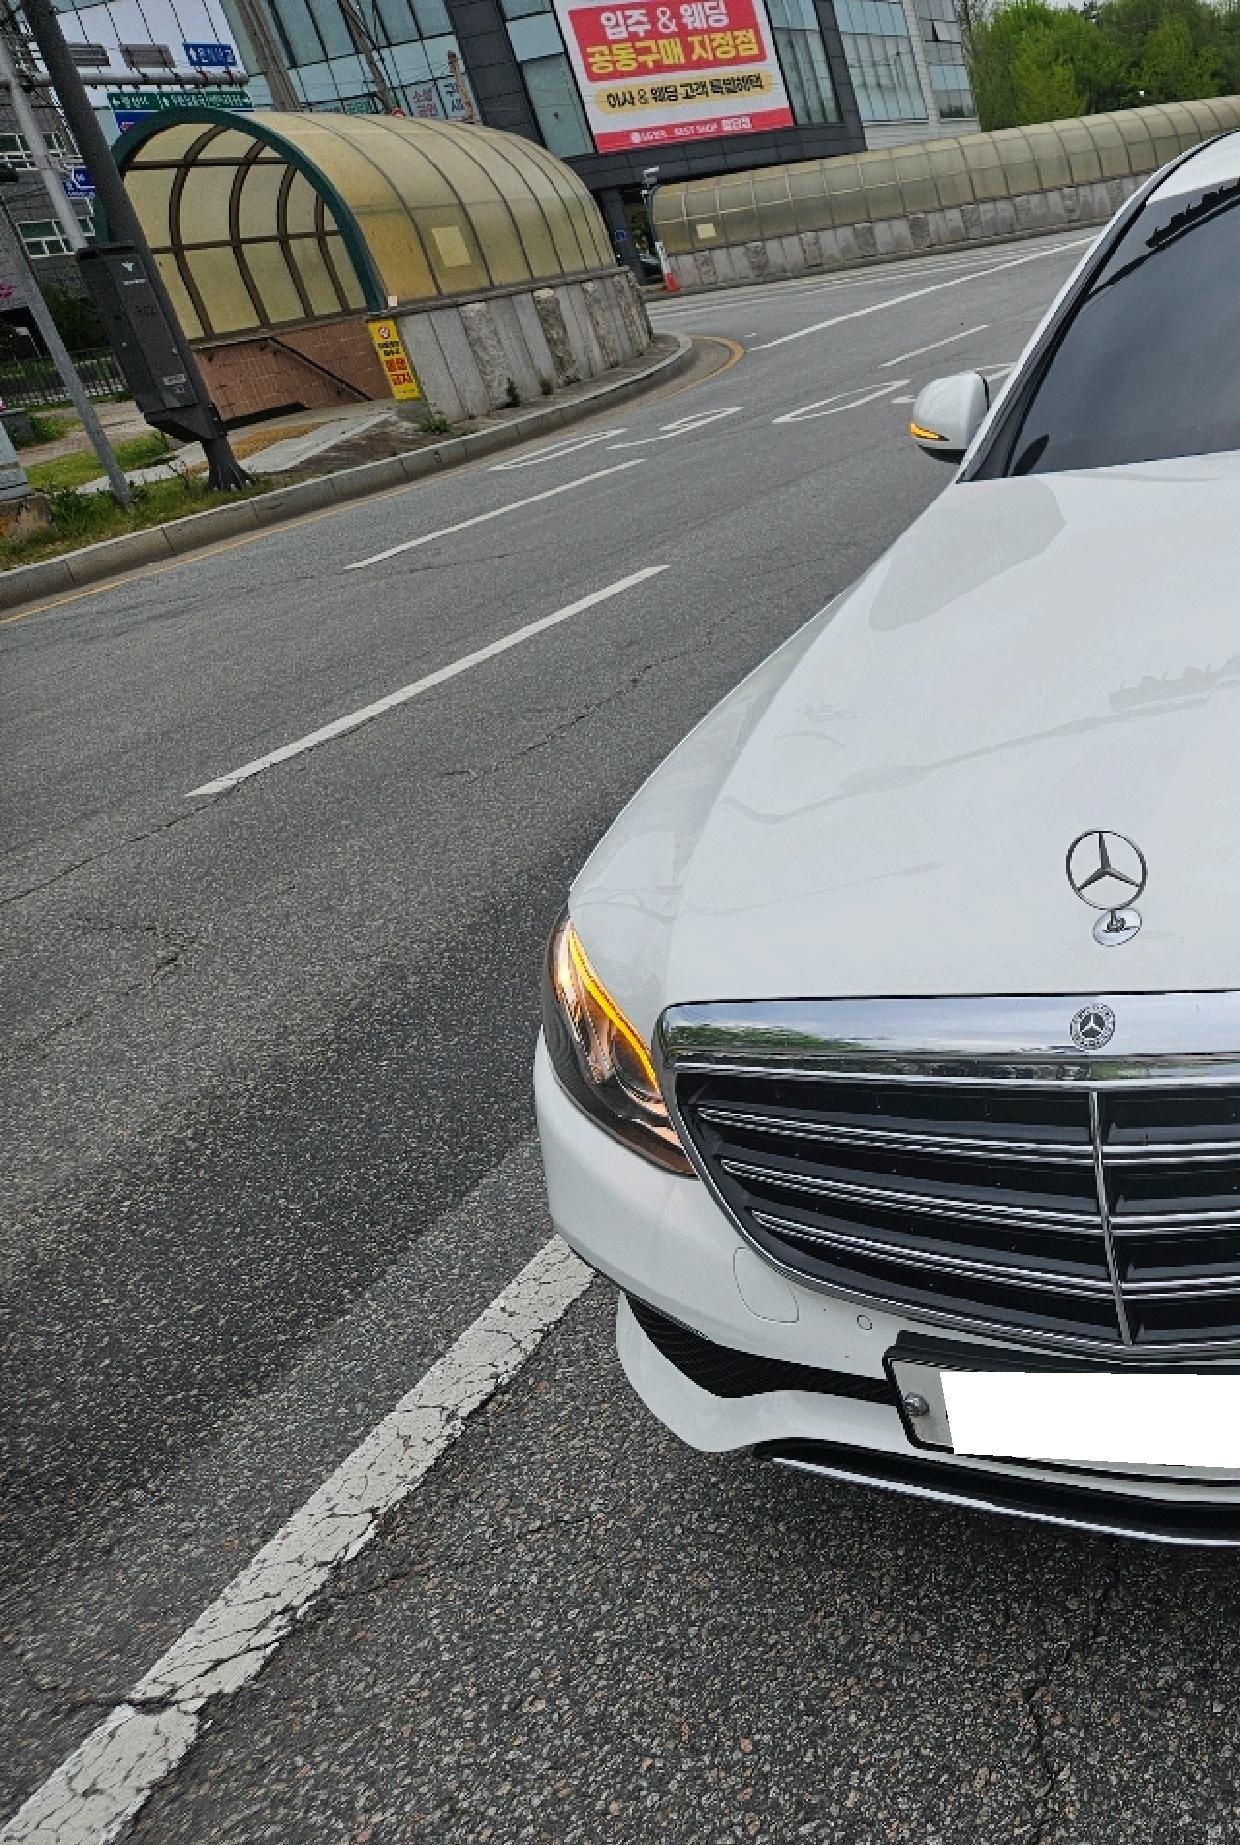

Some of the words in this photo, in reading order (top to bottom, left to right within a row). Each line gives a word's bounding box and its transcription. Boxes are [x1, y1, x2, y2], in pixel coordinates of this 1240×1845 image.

[600, 9, 652, 40] 입주
[657, 7, 678, 33] &
[679, 1, 730, 29] 웨딩
[586, 37, 686, 74] 공동구매
[688, 29, 760, 62] 지정점
[606, 90, 636, 109] 이사
[637, 89, 648, 105] &
[650, 85, 679, 103] 웨딩
[679, 80, 709, 100] 고객
